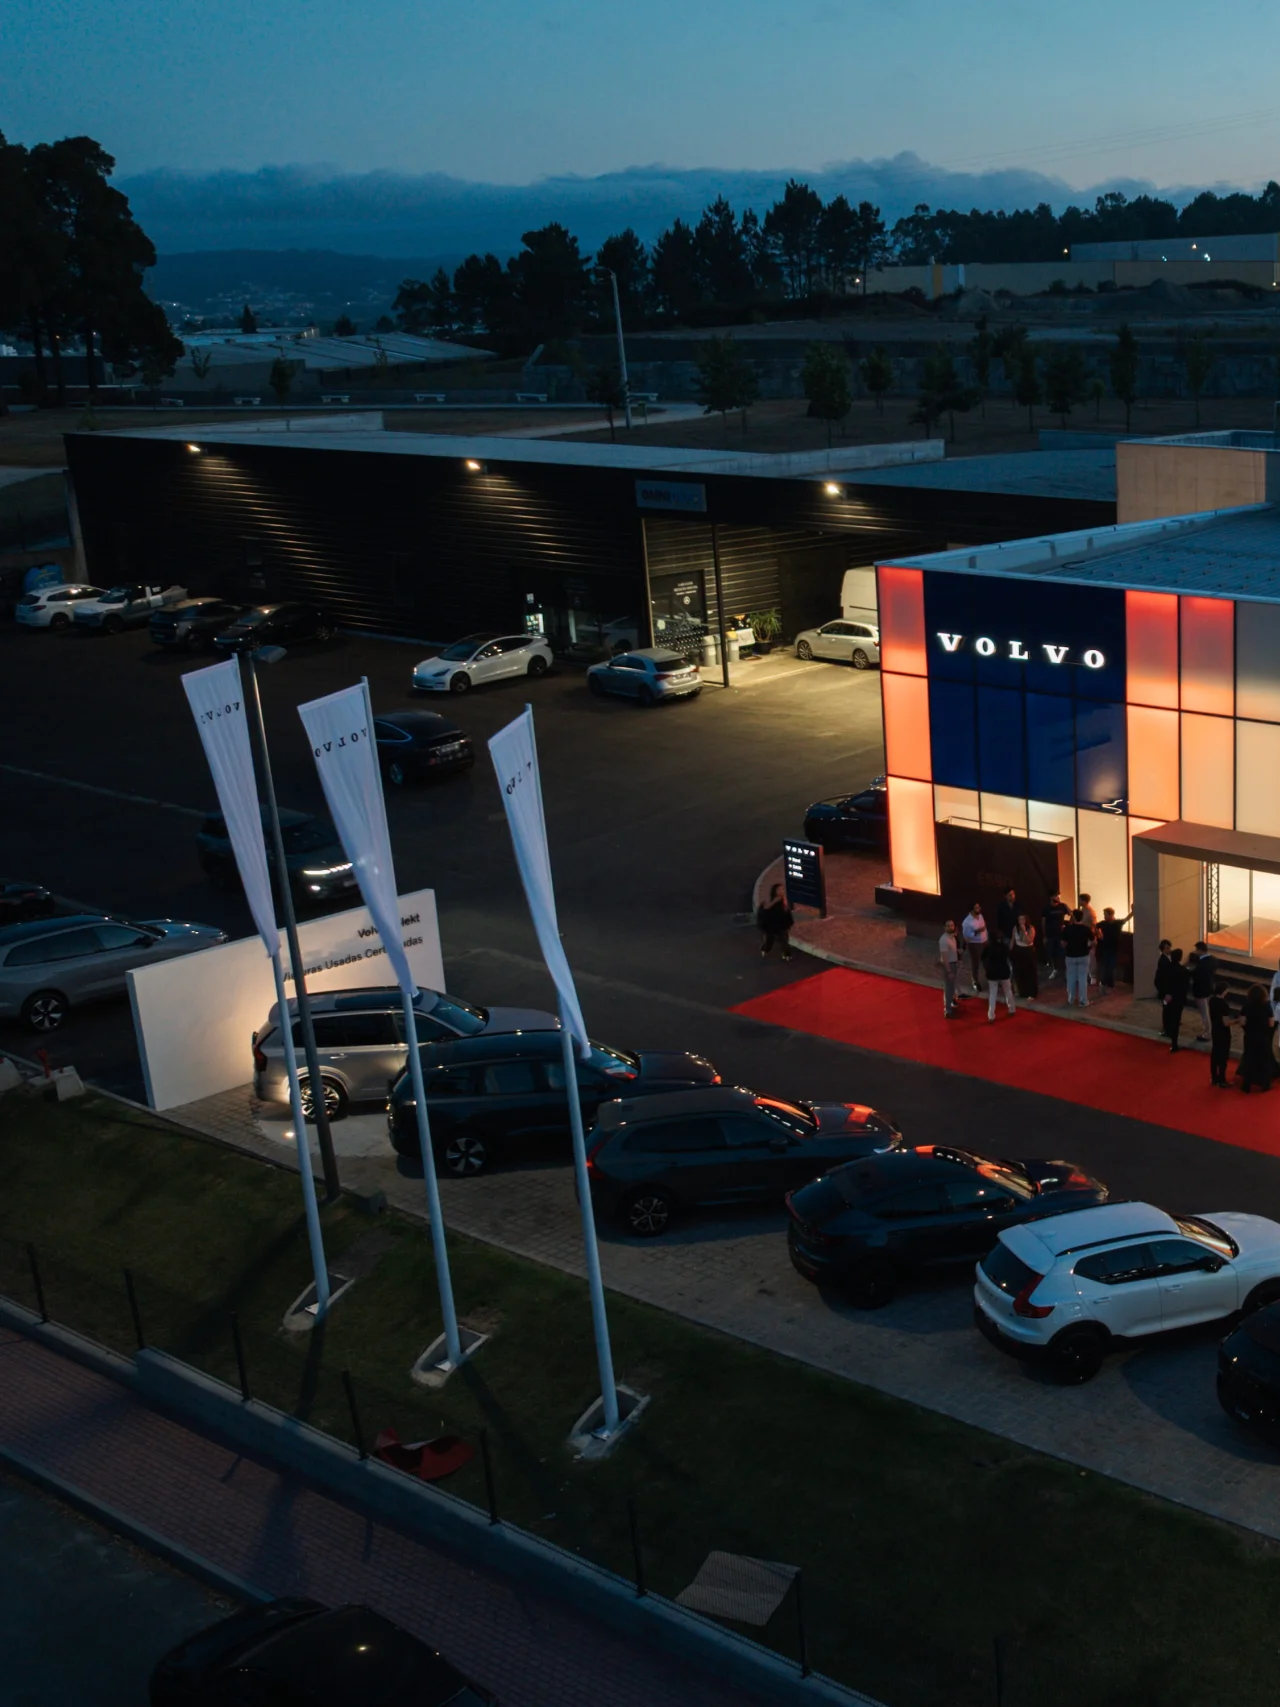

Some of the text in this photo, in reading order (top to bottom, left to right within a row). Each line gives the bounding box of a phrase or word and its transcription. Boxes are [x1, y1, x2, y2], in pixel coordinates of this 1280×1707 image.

[937, 632, 1105, 669] VOLVO
[785, 845, 815, 856] VOLVO
[357, 913, 420, 938] Volv lekt
[325, 952, 362, 969] Usadas
[365, 936, 423, 958] Certdas
